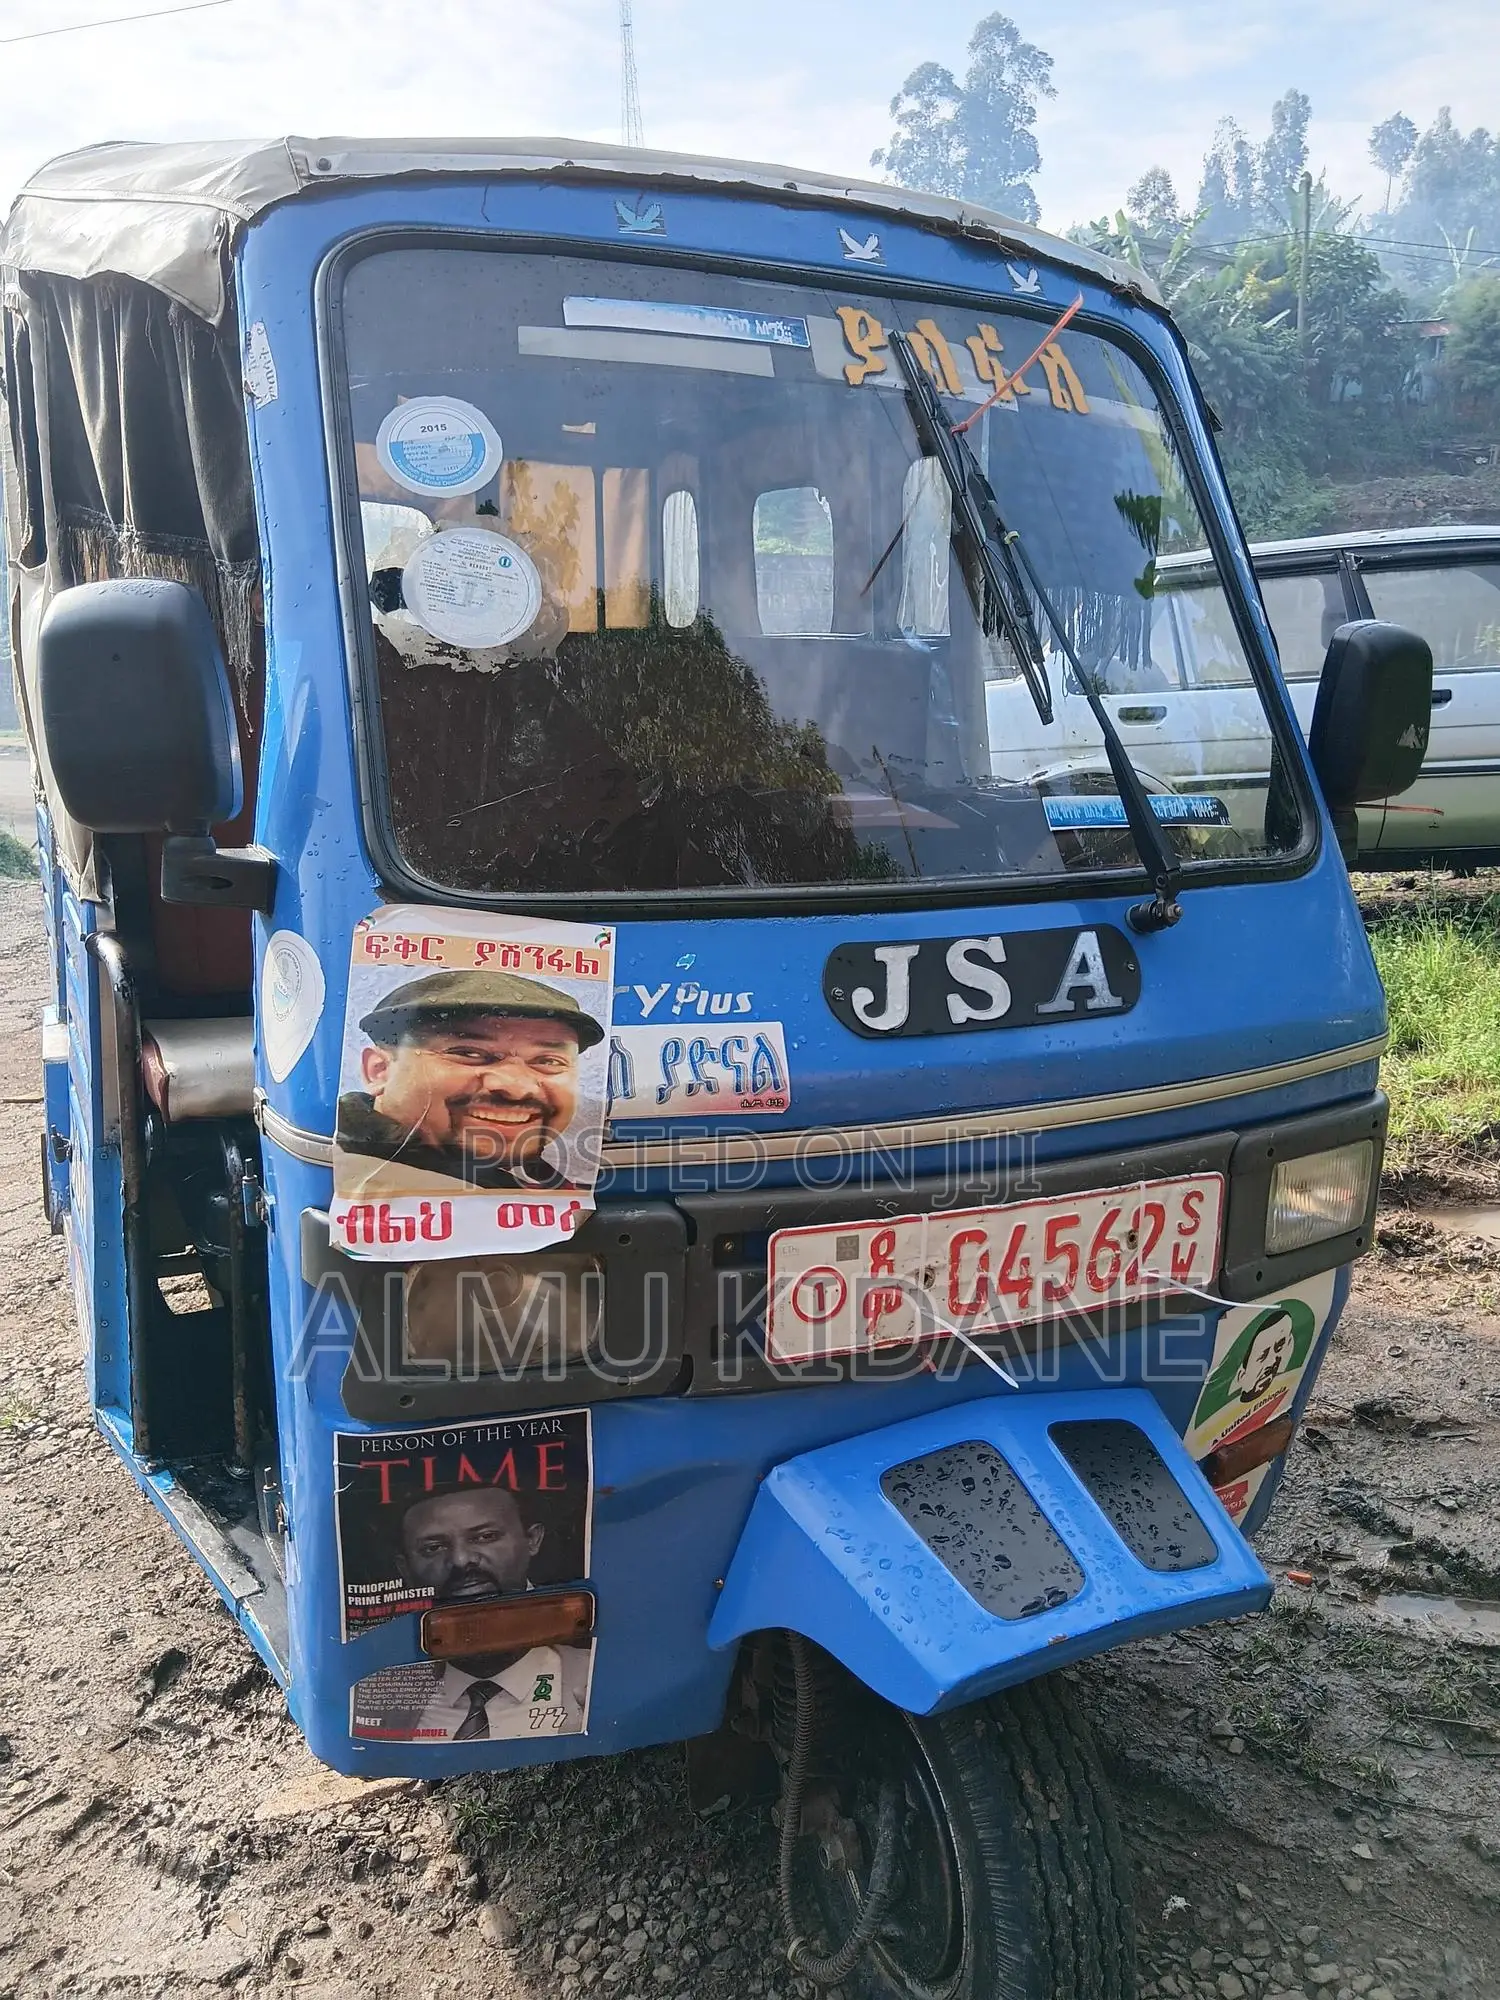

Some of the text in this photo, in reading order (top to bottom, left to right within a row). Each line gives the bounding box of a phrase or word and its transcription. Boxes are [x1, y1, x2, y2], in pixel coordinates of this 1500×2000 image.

[420, 424, 447, 433] 2015
[364, 934, 600, 976] ፍቅር ያሸንፋል
[672, 981, 754, 1016] Plus
[656, 1033, 786, 1104] ያድናል
[337, 1201, 453, 1245] ብልህ
[1178, 1190, 1204, 1235] S
[948, 1203, 1166, 1317] 04562
[1171, 1242, 1198, 1285] W
[361, 1419, 564, 1452] PERSON OF THE YEAR
[360, 1441, 568, 1505] TIME
[348, 1578, 403, 1593] ETHIOPIAN
[348, 1587, 435, 1606] PRIME MINISTER
[355, 1716, 382, 1727] MEET
